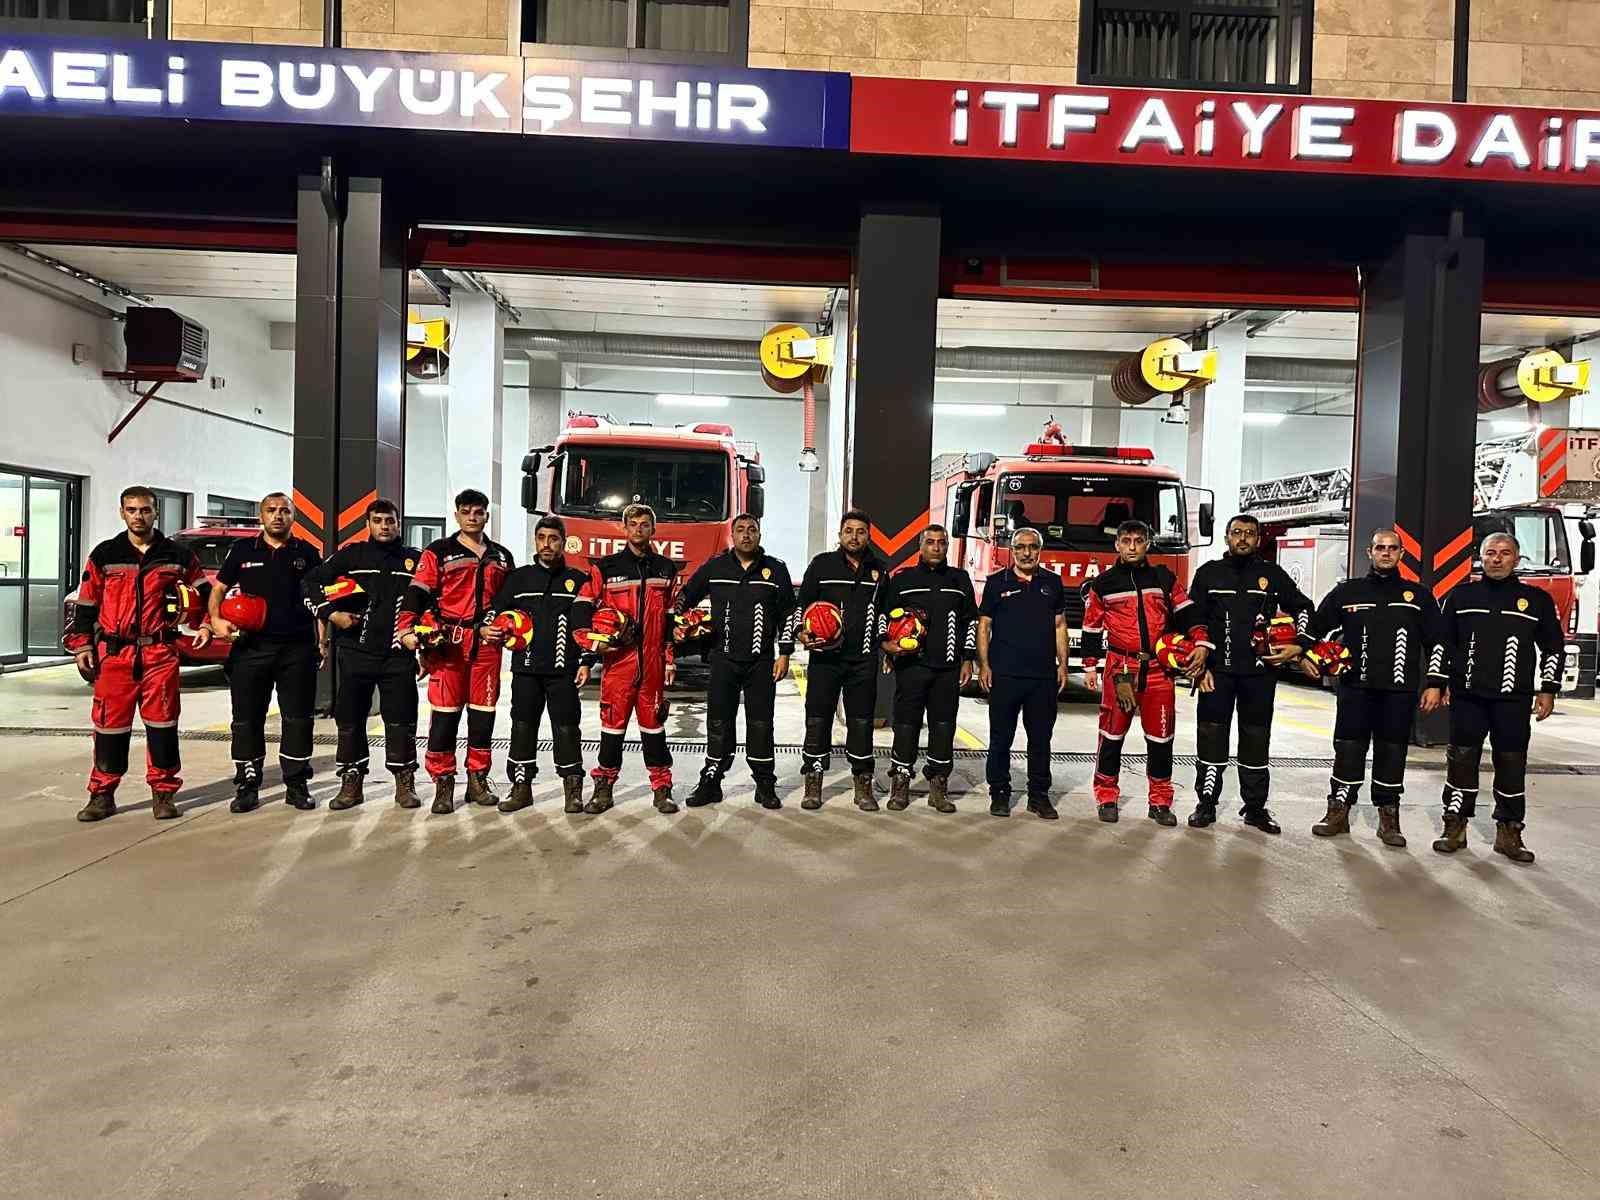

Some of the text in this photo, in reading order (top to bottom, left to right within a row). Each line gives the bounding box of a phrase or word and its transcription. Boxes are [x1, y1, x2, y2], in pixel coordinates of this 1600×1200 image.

[220, 59, 769, 132] BÜYÜKŞEHİR
[953, 89, 1356, 160] İTFAİYE
[588, 538, 685, 559] İTFYE
